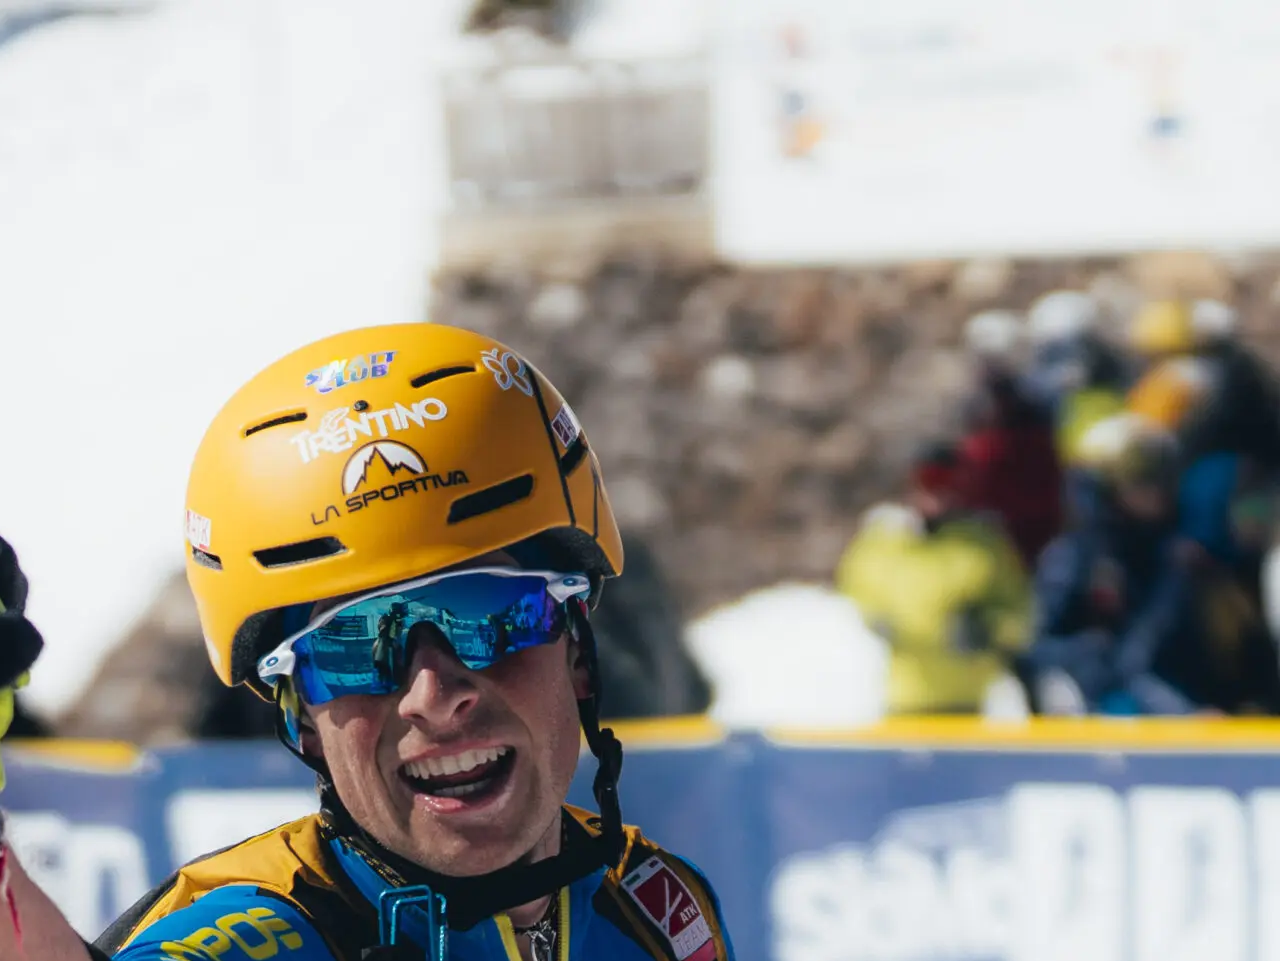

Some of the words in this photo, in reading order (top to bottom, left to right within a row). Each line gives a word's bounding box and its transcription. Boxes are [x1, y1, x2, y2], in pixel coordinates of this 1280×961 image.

[289, 397, 448, 465] TRENTINO
[311, 505, 340, 526] LA
[345, 470, 469, 513] SPORTIVA
[679, 903, 698, 924] ATK
